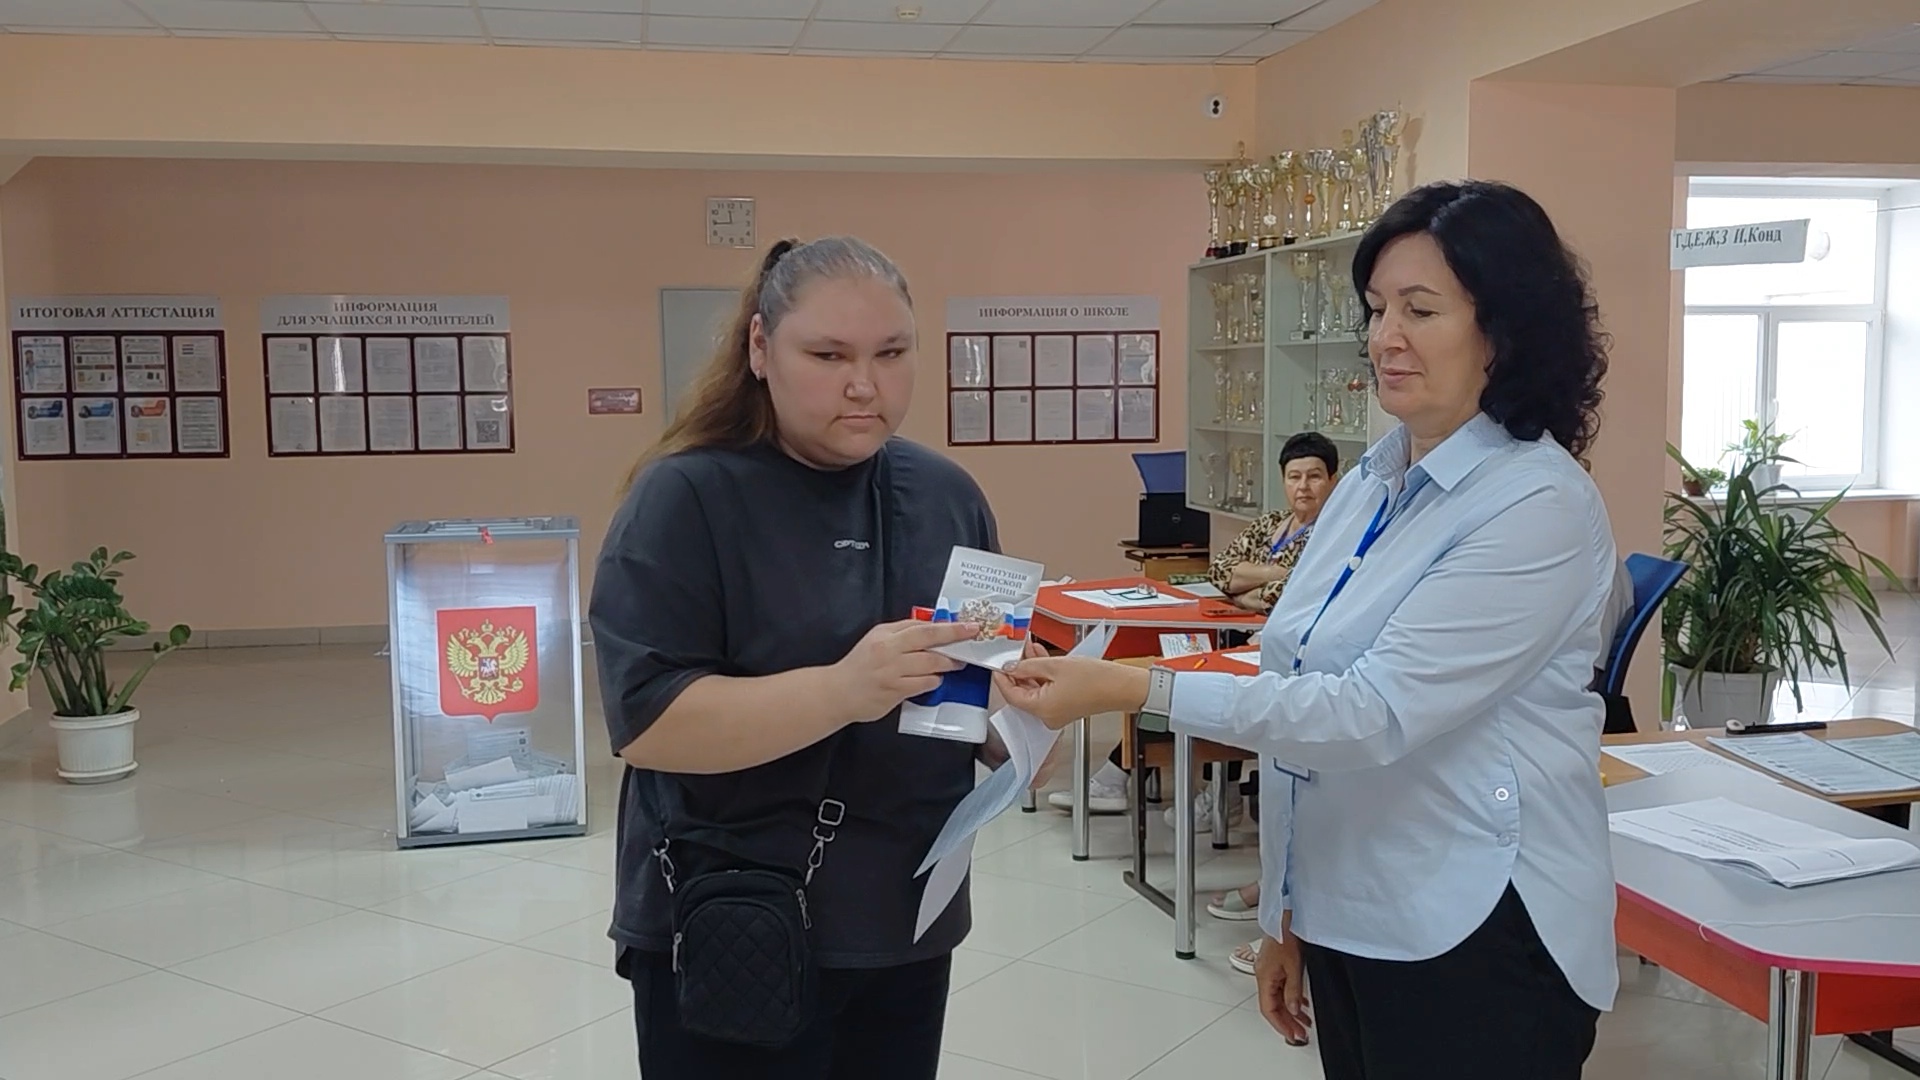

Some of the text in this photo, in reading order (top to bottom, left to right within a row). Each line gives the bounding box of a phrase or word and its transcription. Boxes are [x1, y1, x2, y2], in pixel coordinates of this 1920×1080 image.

[19, 306, 215, 320] ИТОГОВАЯ АТТЕСТАЦИЯ
[334, 301, 438, 313] ИНФОРМАЦИЯ
[978, 306, 1129, 318] ИНФОРМАЦИЯ О ШКОЛЕ
[277, 313, 495, 327] ДЛЯ УЧАЩИХСЯ И РОДИТЕЛЕЙ
[961, 562, 1027, 581] КОНСТИТУЦИЯ
[961, 571, 1023, 589] РОССИЙСКОЙ
[963, 580, 1016, 596] ФЕДЕРАЦИИ
